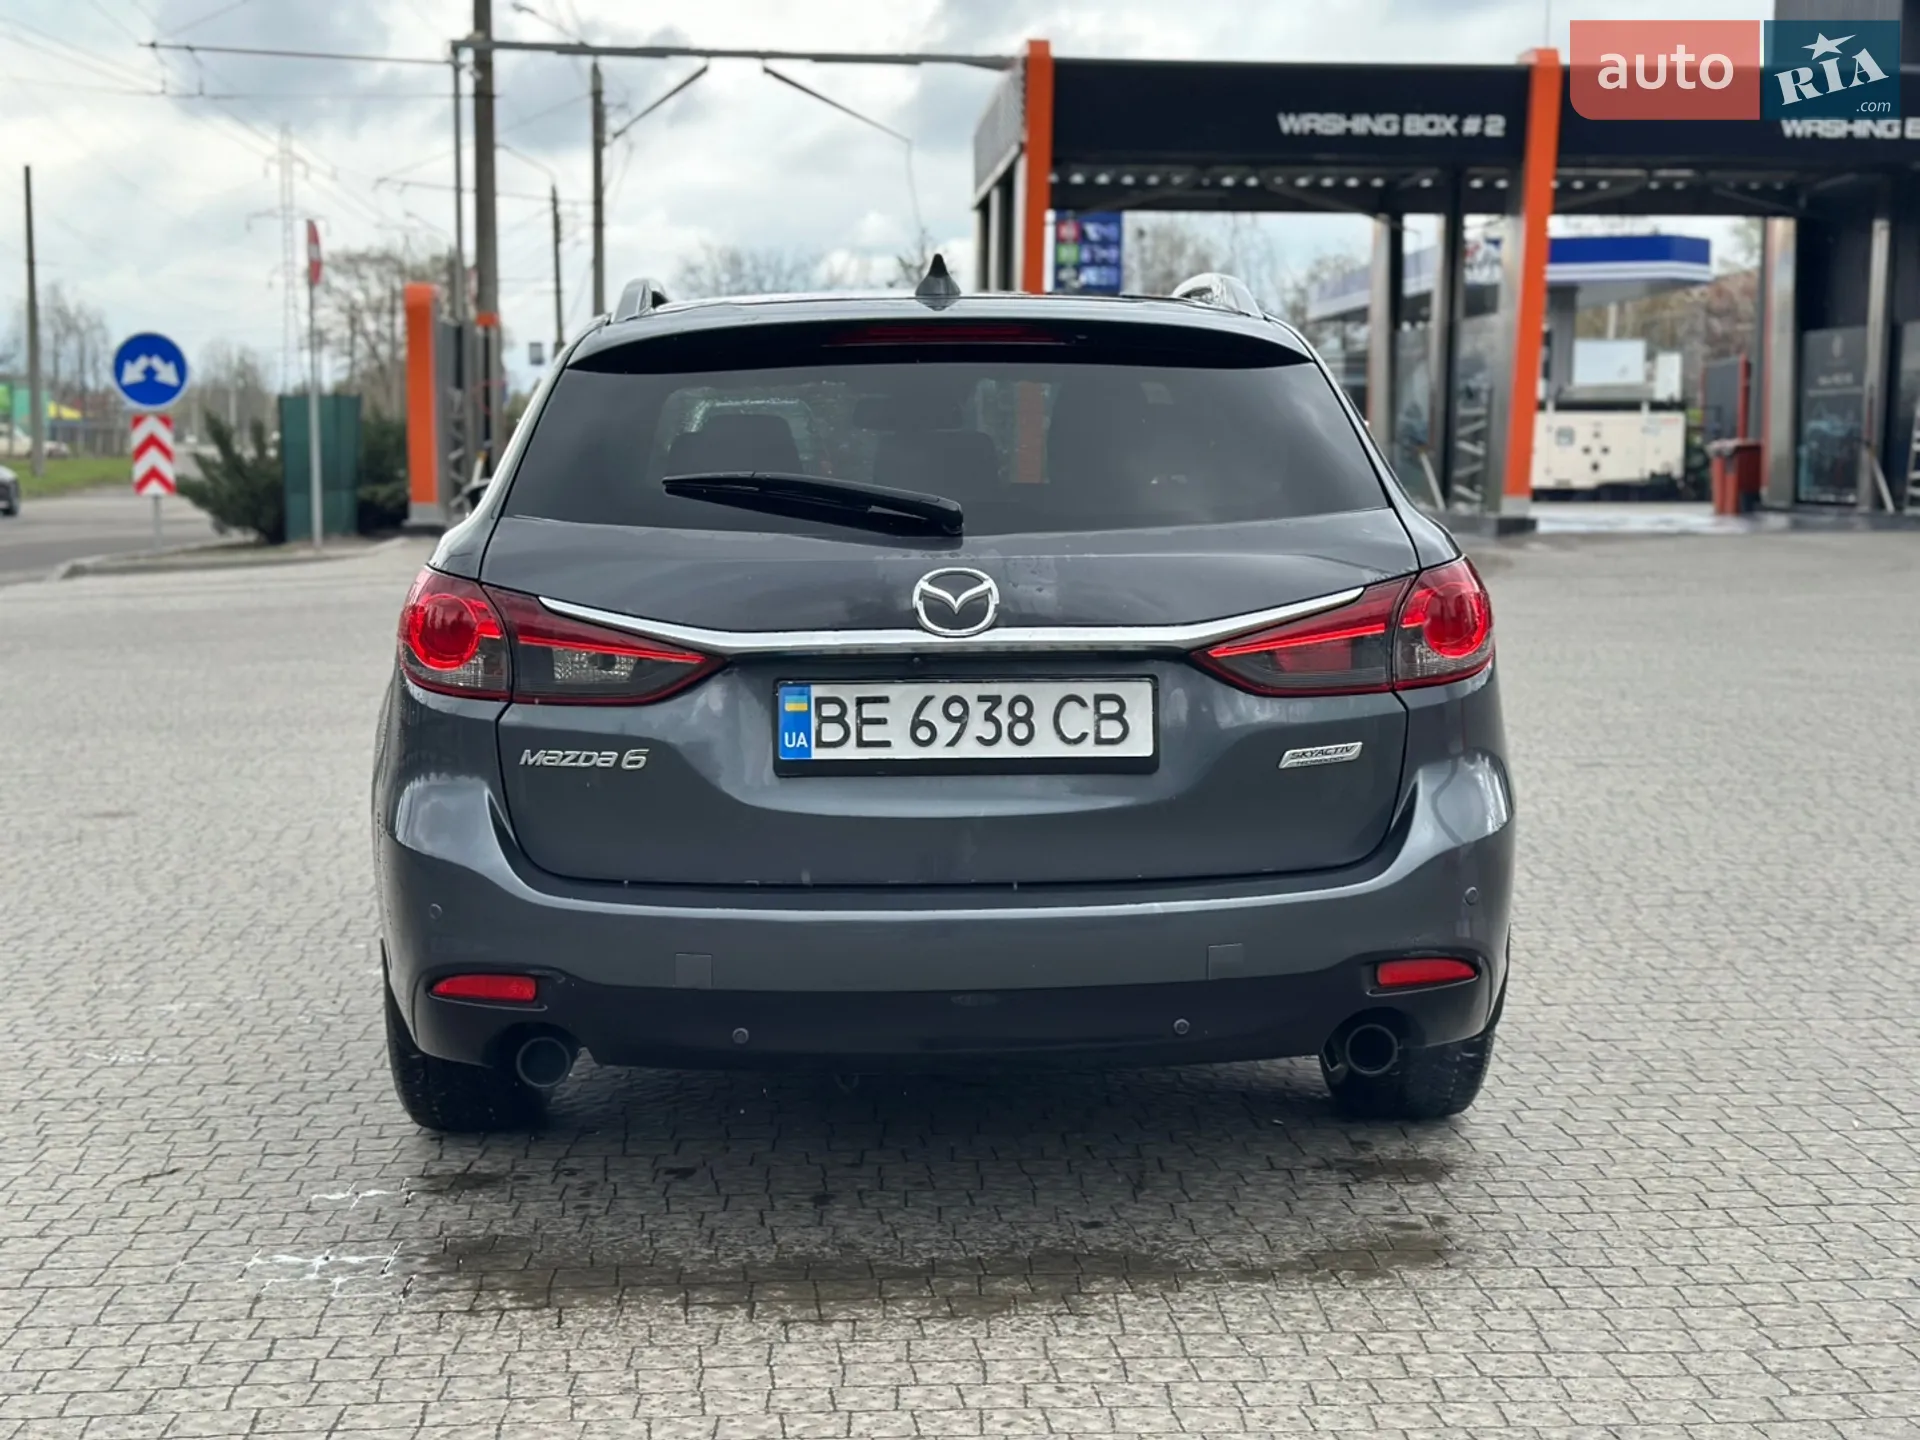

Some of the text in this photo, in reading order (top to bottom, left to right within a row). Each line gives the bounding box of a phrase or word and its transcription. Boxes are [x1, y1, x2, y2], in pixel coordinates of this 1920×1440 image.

[1277, 113, 1399, 135] WASHING
[1403, 114, 1458, 136] BOX
[1780, 118, 1901, 138] WASHING
[814, 693, 1130, 748] BE 6938 CB
[784, 731, 808, 748] UA
[621, 748, 650, 770] 6
[1290, 745, 1355, 759] SKYACTIV
